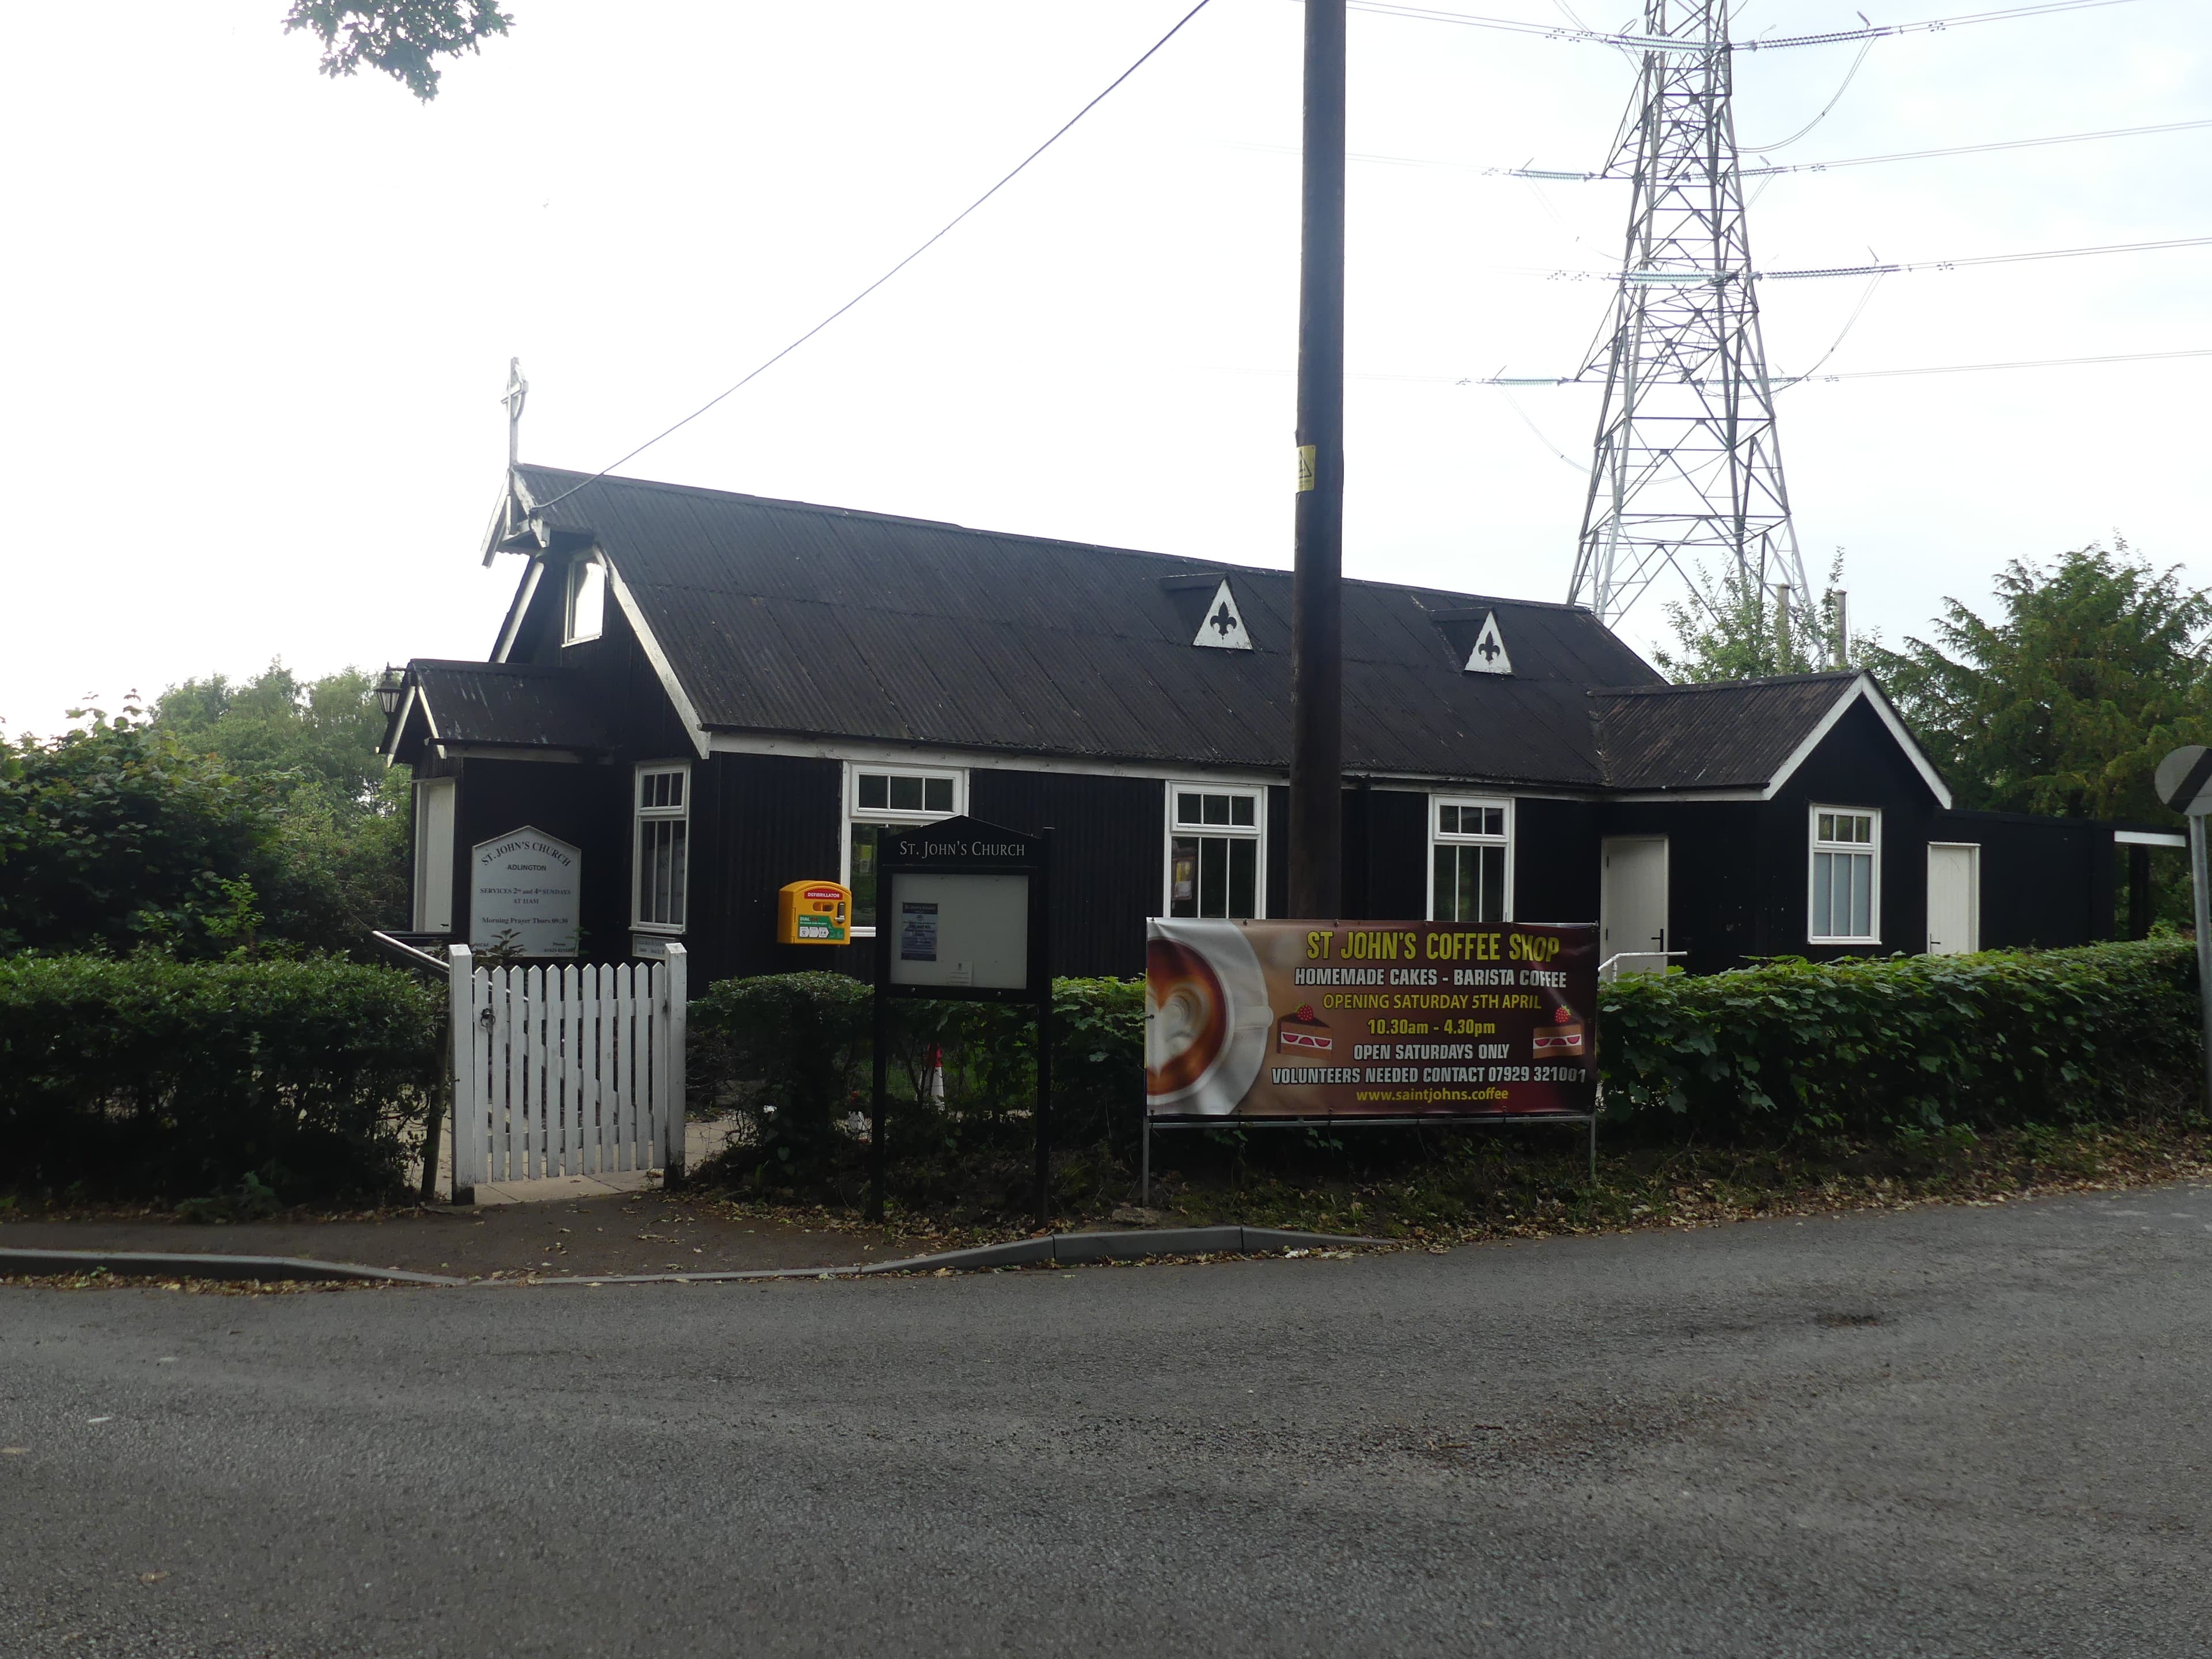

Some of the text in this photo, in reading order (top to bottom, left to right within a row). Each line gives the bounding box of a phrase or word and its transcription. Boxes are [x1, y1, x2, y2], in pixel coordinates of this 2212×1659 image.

[482, 841, 571, 867] ST. JOHN'S CHURCH
[900, 840, 1025, 859] ST. JOHN'S CHURCH
[1306, 931, 1559, 963] ST JOHN'S COFFEE SHOP
[1295, 968, 1384, 986] HOMEMADE
[1389, 968, 1437, 986] CAKES
[1454, 969, 1514, 986] BARISTA
[1520, 970, 1566, 988] COFFEE
[1323, 994, 1541, 1009] OPENING SATURDAY 5TH APRIL
[1368, 1019, 1428, 1035] 10.30am
[1444, 1019, 1495, 1037] 4.30pm
[1354, 1044, 1510, 1059] OPEN SATURDAYS ONLY
[1272, 1067, 1585, 1084] VOLUNTEERS NEEDED CONTACT 07929 321001
[1356, 1088, 1508, 1103] www.saintjohns.coffee
